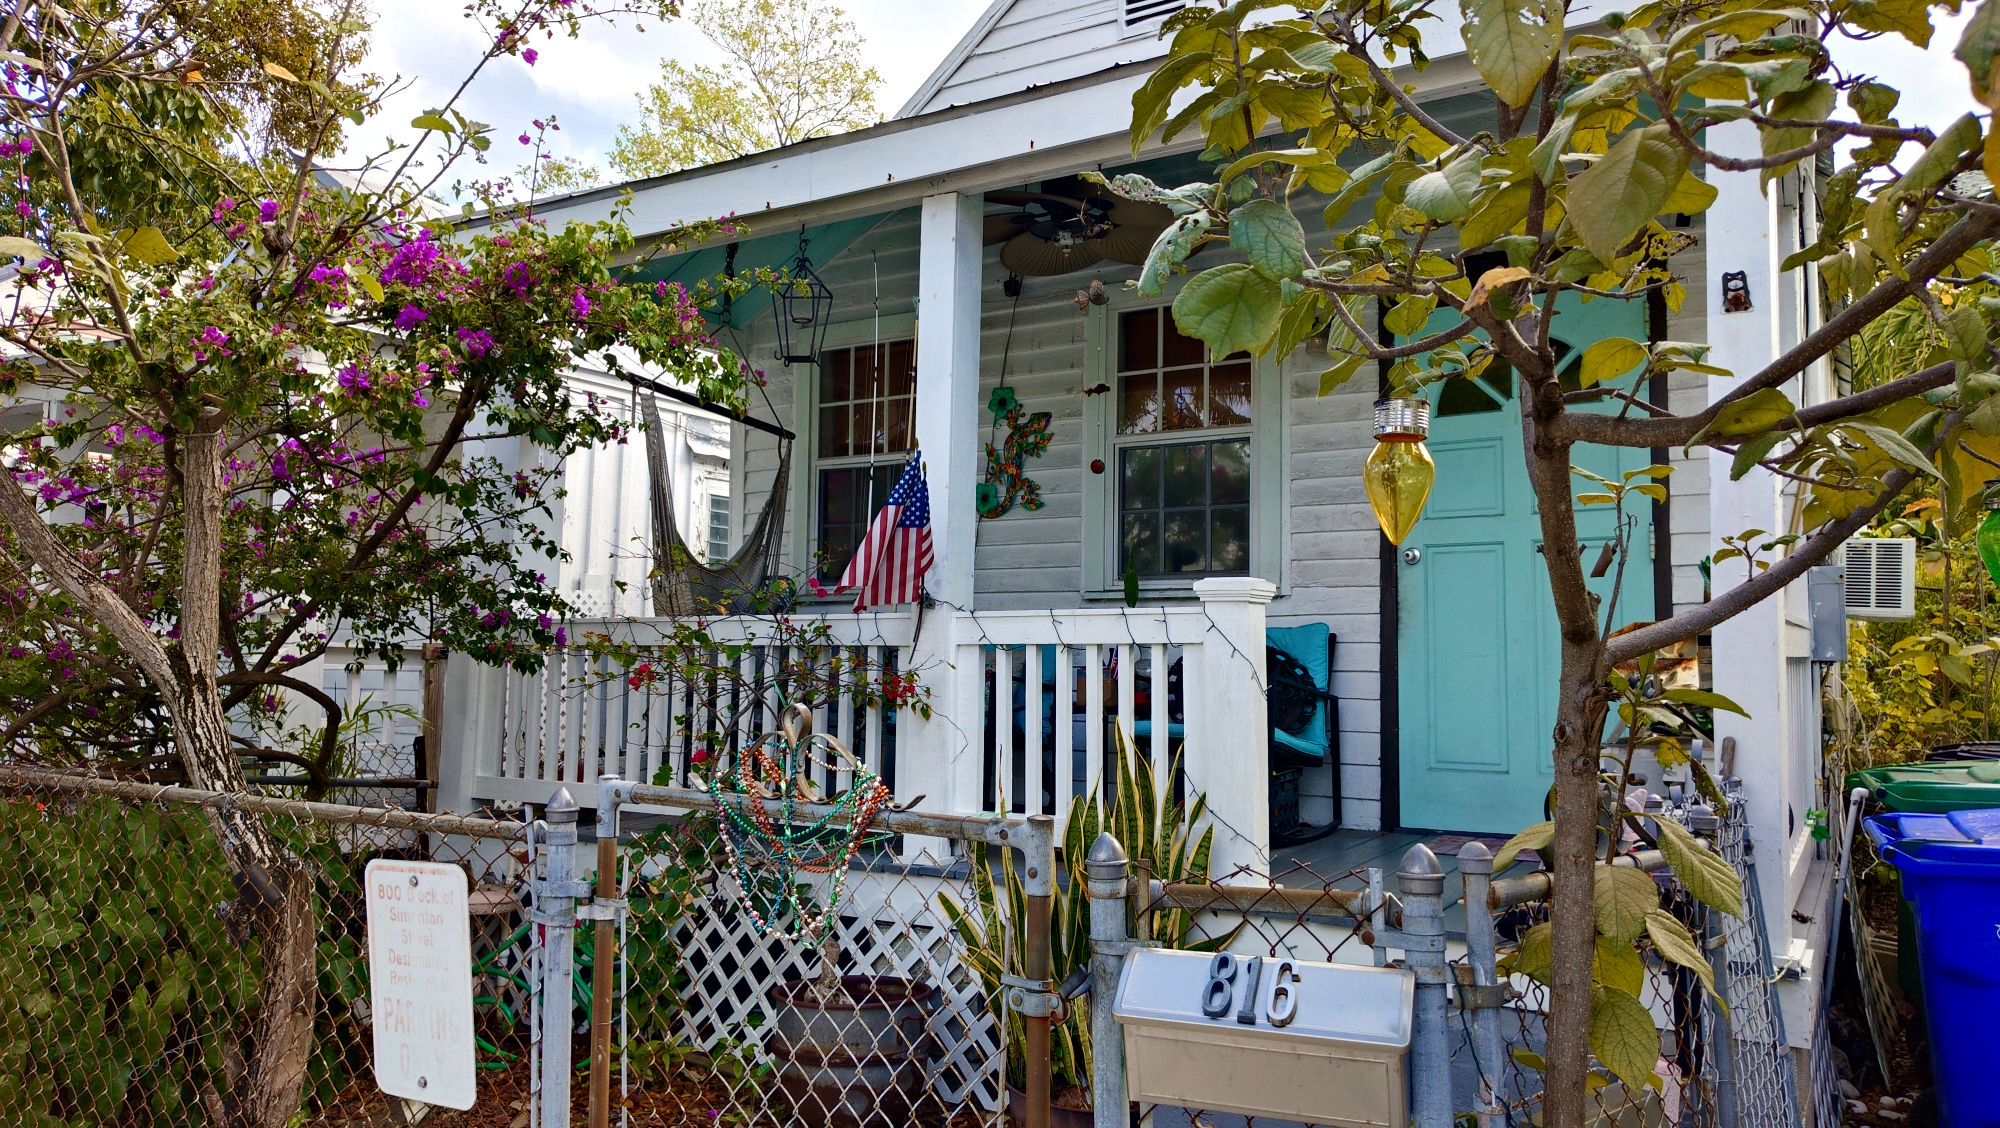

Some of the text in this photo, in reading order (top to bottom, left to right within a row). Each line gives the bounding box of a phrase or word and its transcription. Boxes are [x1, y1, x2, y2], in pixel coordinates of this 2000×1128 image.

[378, 883, 454, 906] 800 Bock of
[401, 928, 434, 948] Steet
[388, 948, 449, 972] Desinated
[390, 970, 451, 993] Resintia
[1202, 951, 1301, 1028] 816
